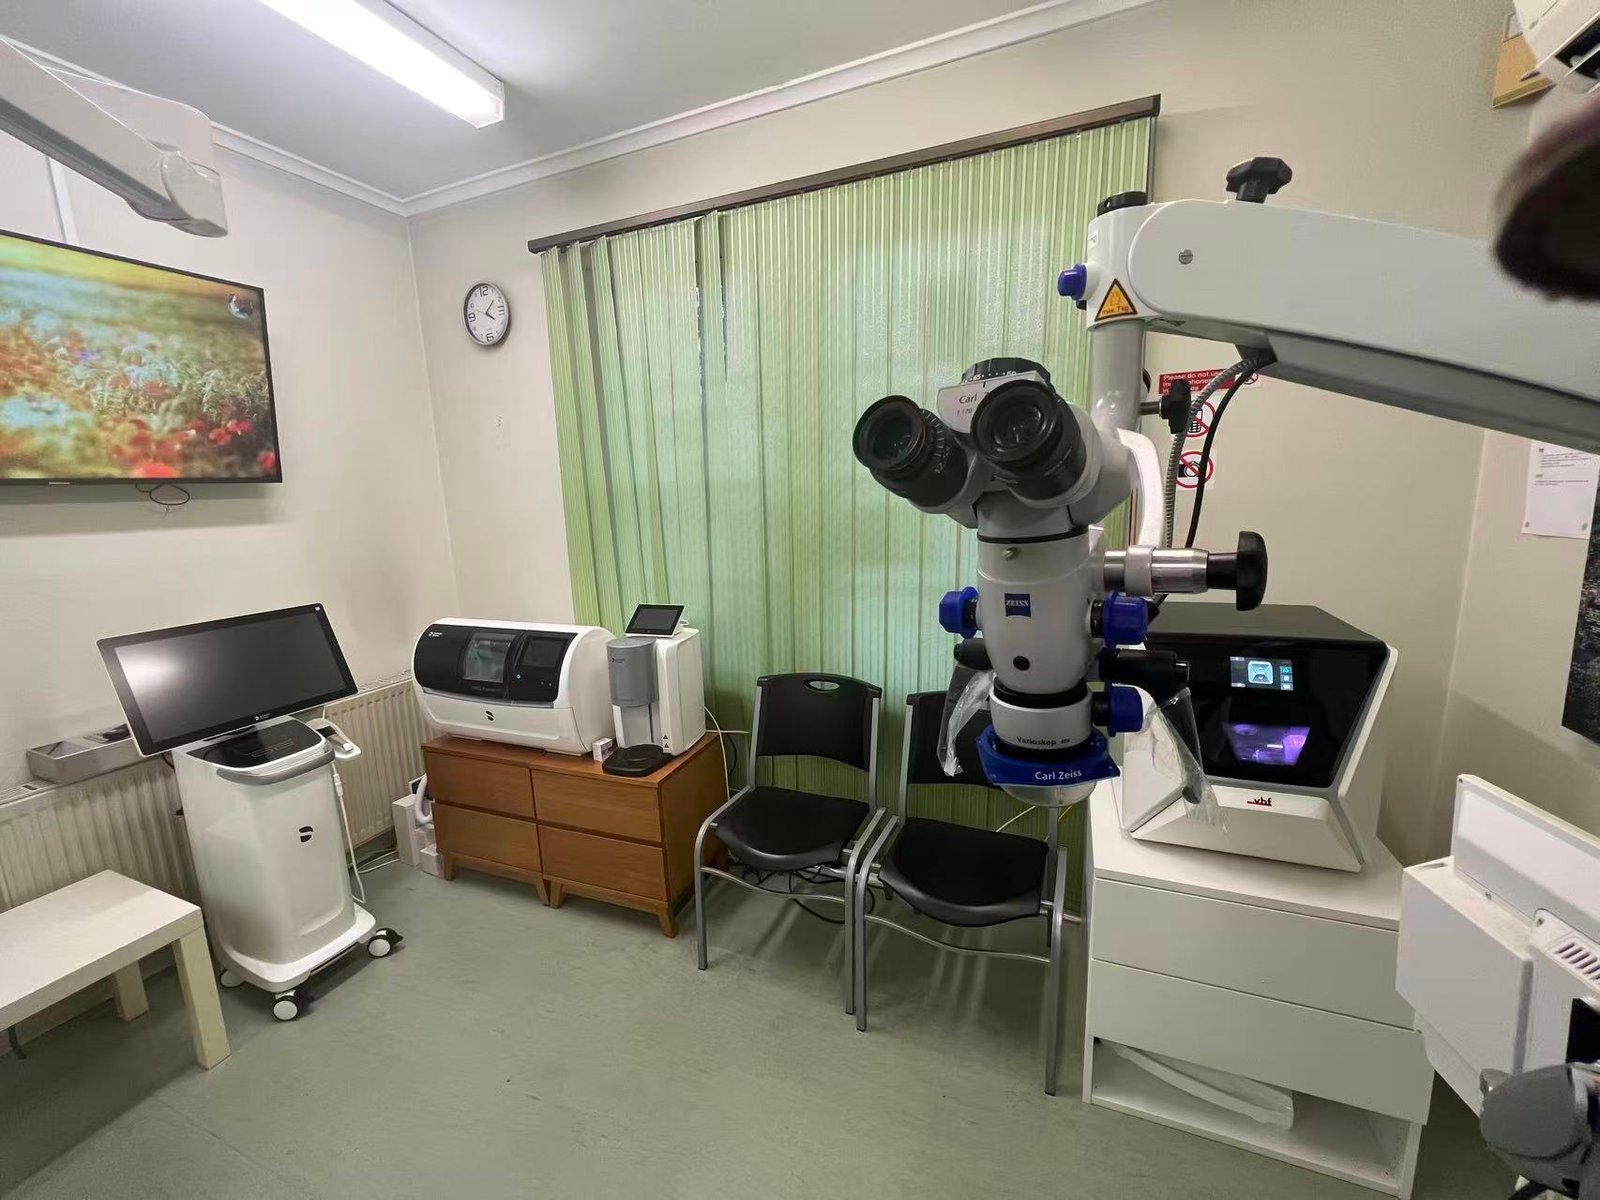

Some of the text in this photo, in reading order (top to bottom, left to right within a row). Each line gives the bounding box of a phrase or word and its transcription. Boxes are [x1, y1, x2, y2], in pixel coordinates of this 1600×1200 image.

[479, 285, 489, 297] 12
[486, 332, 495, 342] 6
[959, 392, 978, 404] Carl
[1016, 736, 1057, 747] Varioskop
[1034, 769, 1083, 781] Carl Zeiss
